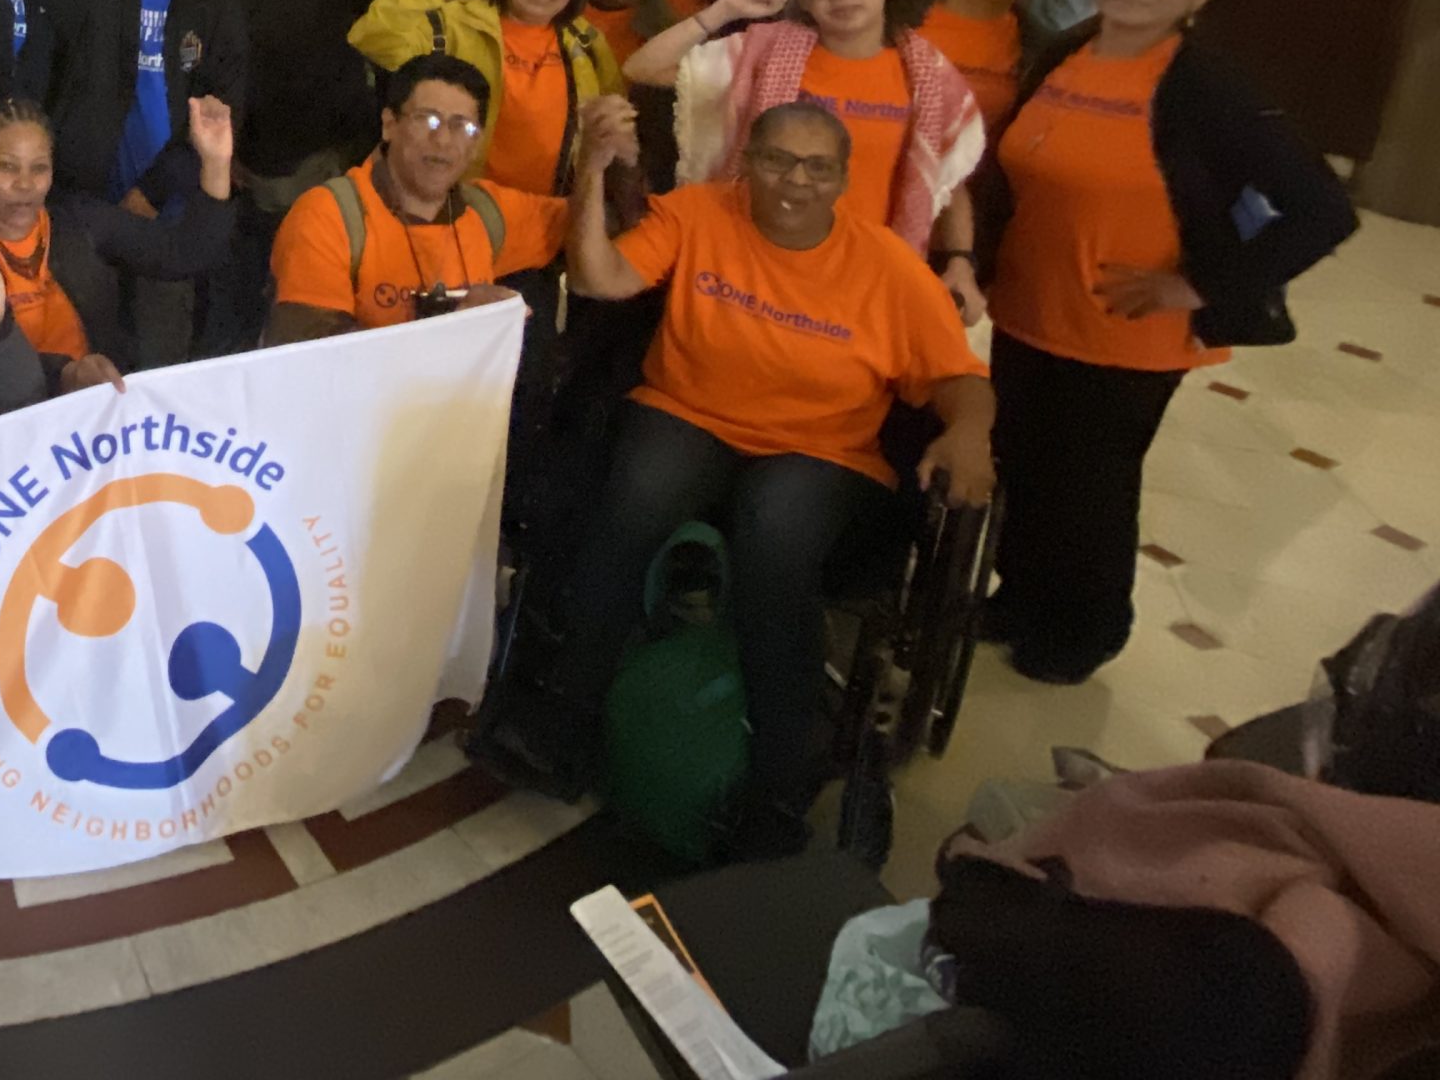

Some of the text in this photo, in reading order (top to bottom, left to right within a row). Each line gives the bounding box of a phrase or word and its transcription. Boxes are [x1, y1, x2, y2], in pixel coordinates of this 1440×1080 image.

[718, 282, 853, 341] ONE Northside
[50, 413, 285, 491] Northside
[303, 515, 351, 659] EQUALITY
[293, 673, 336, 729] FOR
[30, 735, 291, 841] NEIGHBORHOODS
